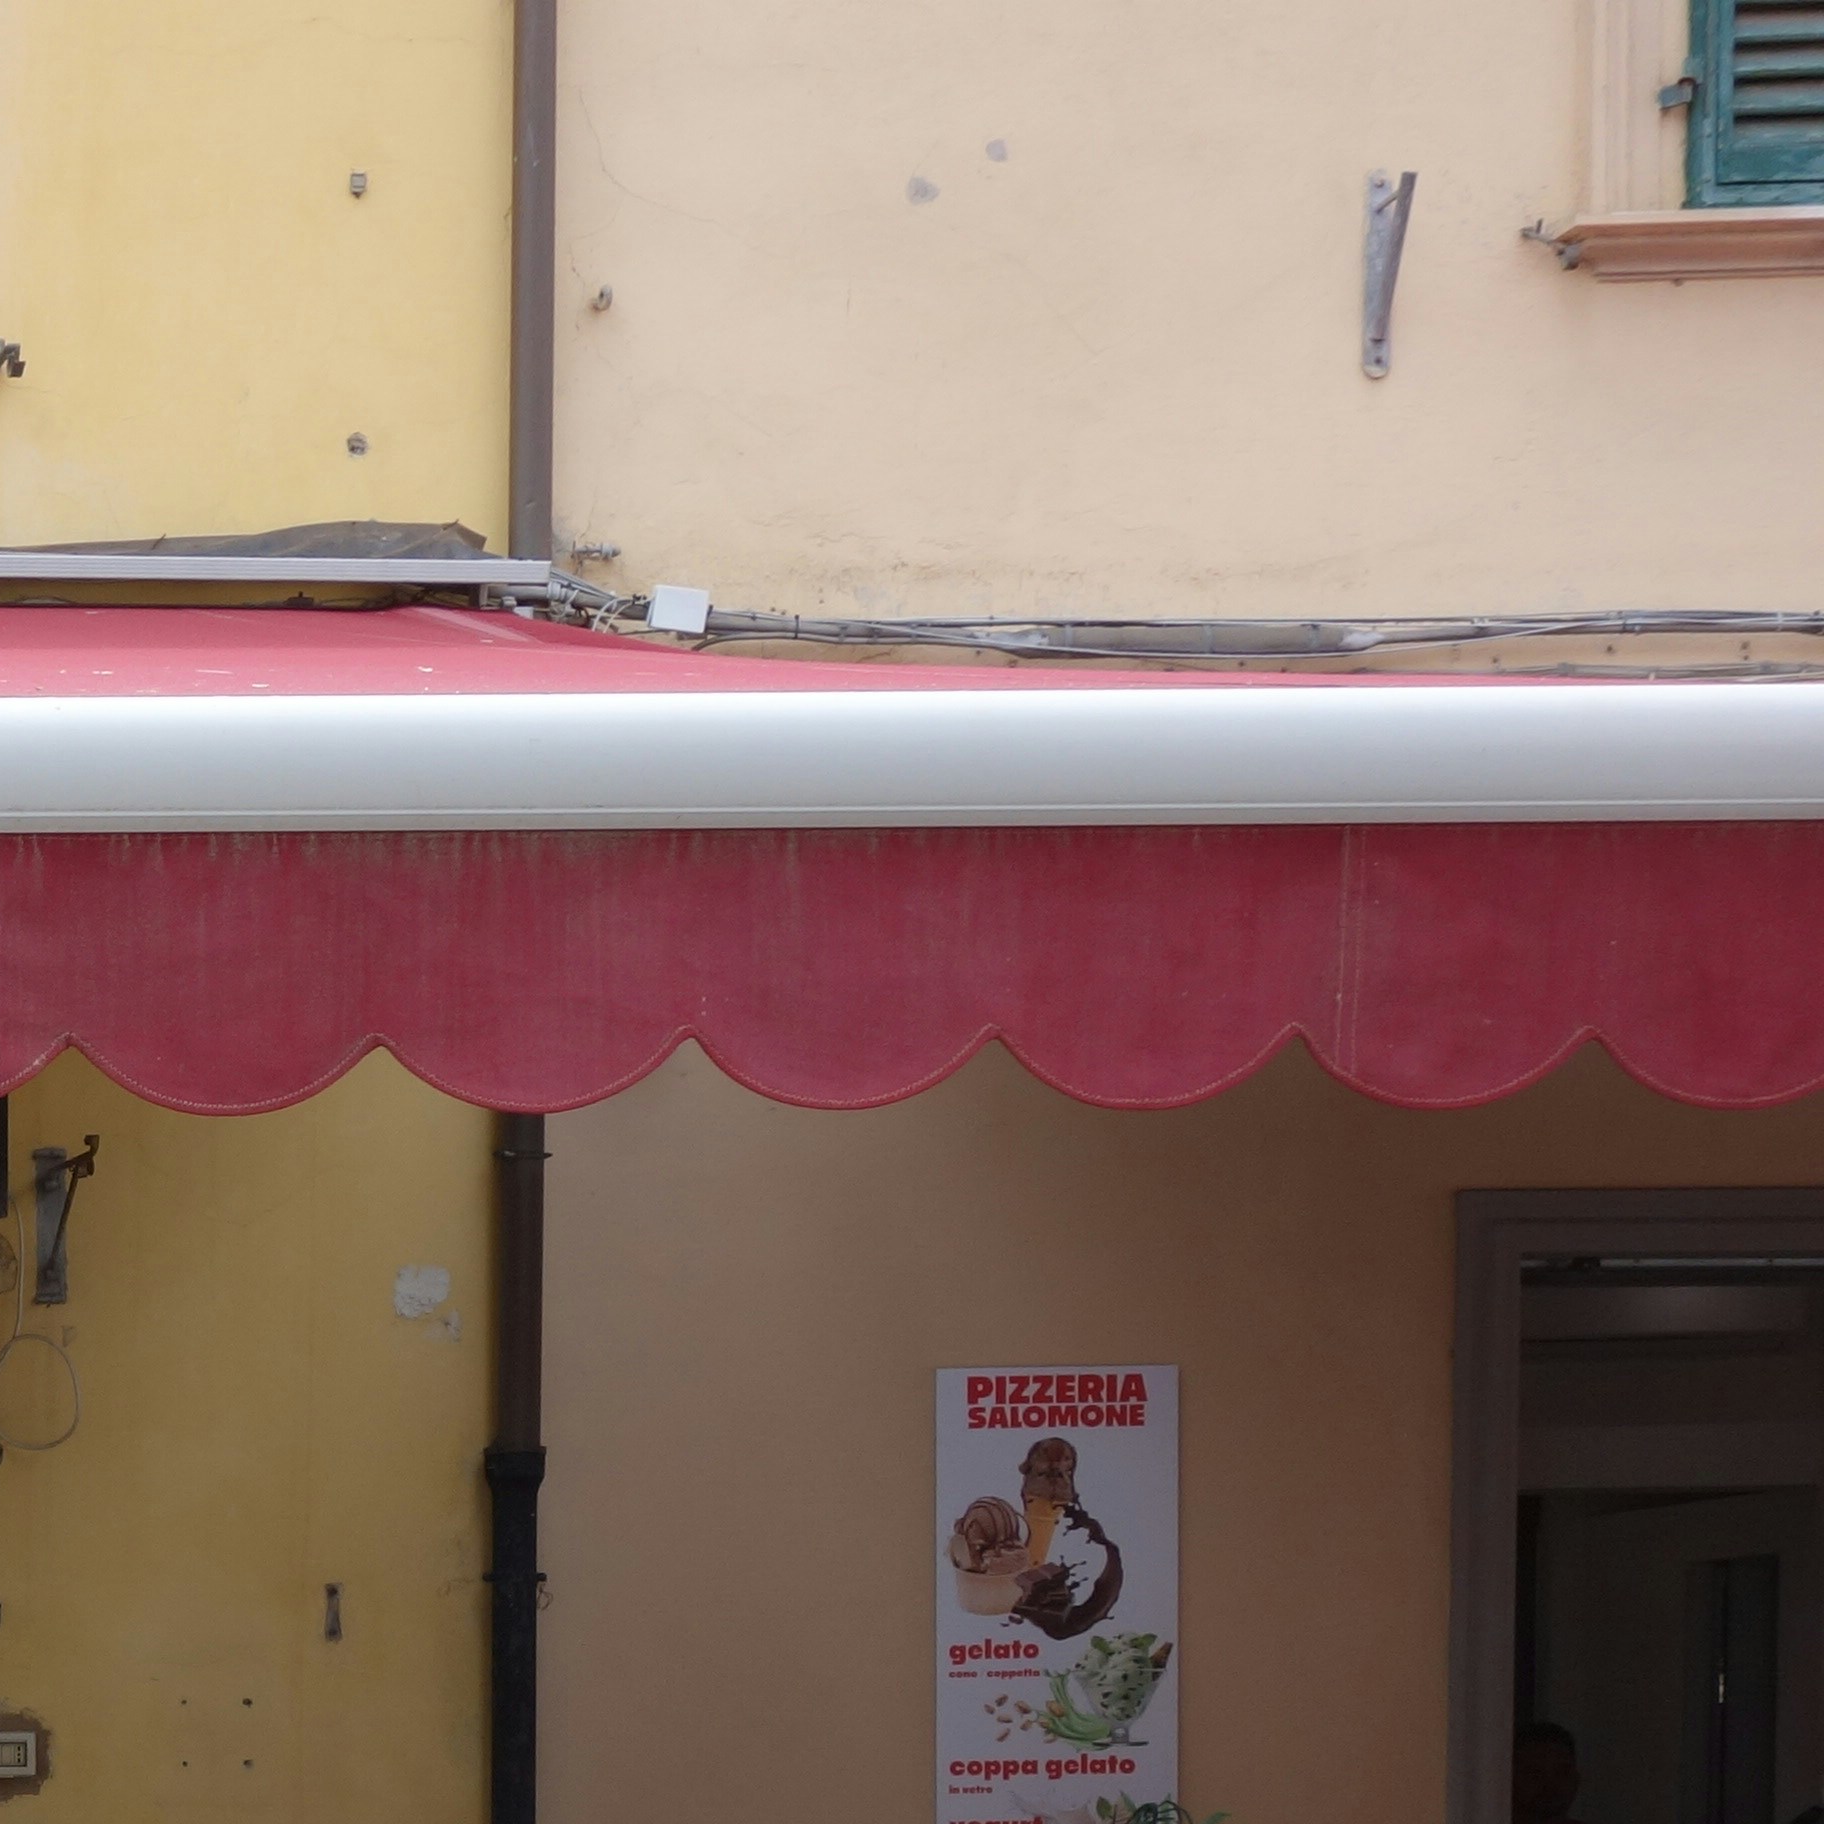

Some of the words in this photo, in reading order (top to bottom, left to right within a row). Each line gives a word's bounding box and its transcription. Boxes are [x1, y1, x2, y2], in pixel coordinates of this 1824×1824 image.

[966, 1374, 1147, 1405] PIZZERIA
[968, 1406, 1145, 1429] SALOMONE
[949, 1639, 1039, 1664] gelato
[949, 1670, 978, 1679] cono
[949, 1759, 1039, 1780] coppa
[1045, 1754, 1136, 1780] gelato
